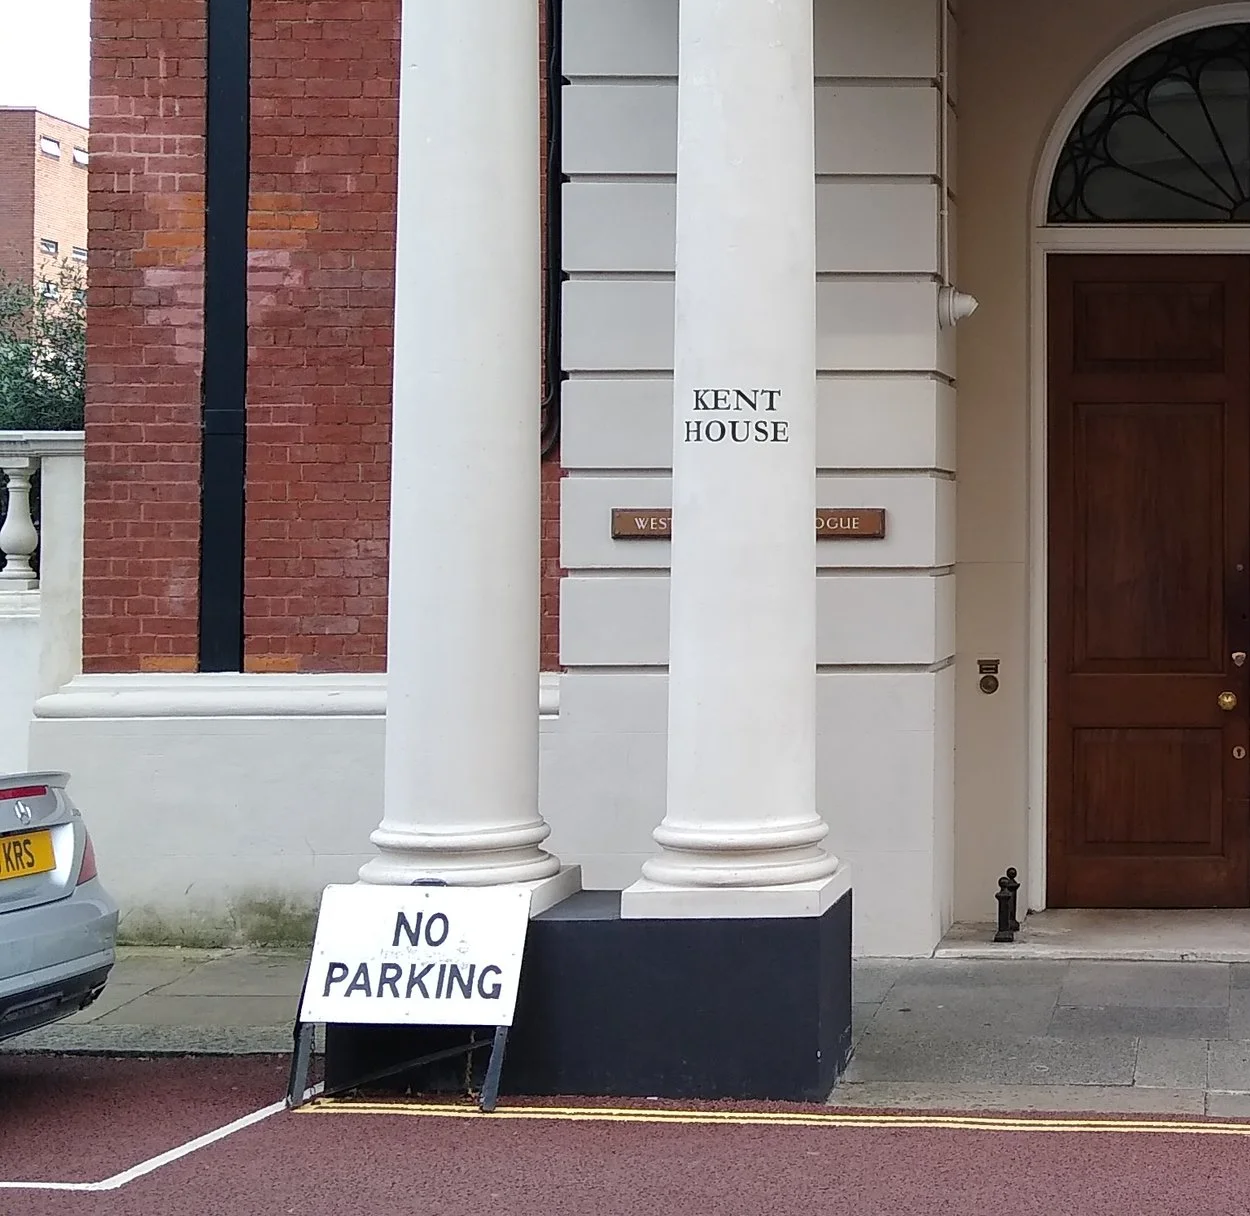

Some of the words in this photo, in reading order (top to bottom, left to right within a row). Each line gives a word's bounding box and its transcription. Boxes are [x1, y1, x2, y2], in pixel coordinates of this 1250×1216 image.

[692, 388, 781, 412] KENT
[684, 420, 789, 443] HOUSE
[392, 911, 449, 947] NO
[322, 962, 502, 999] PARKING
